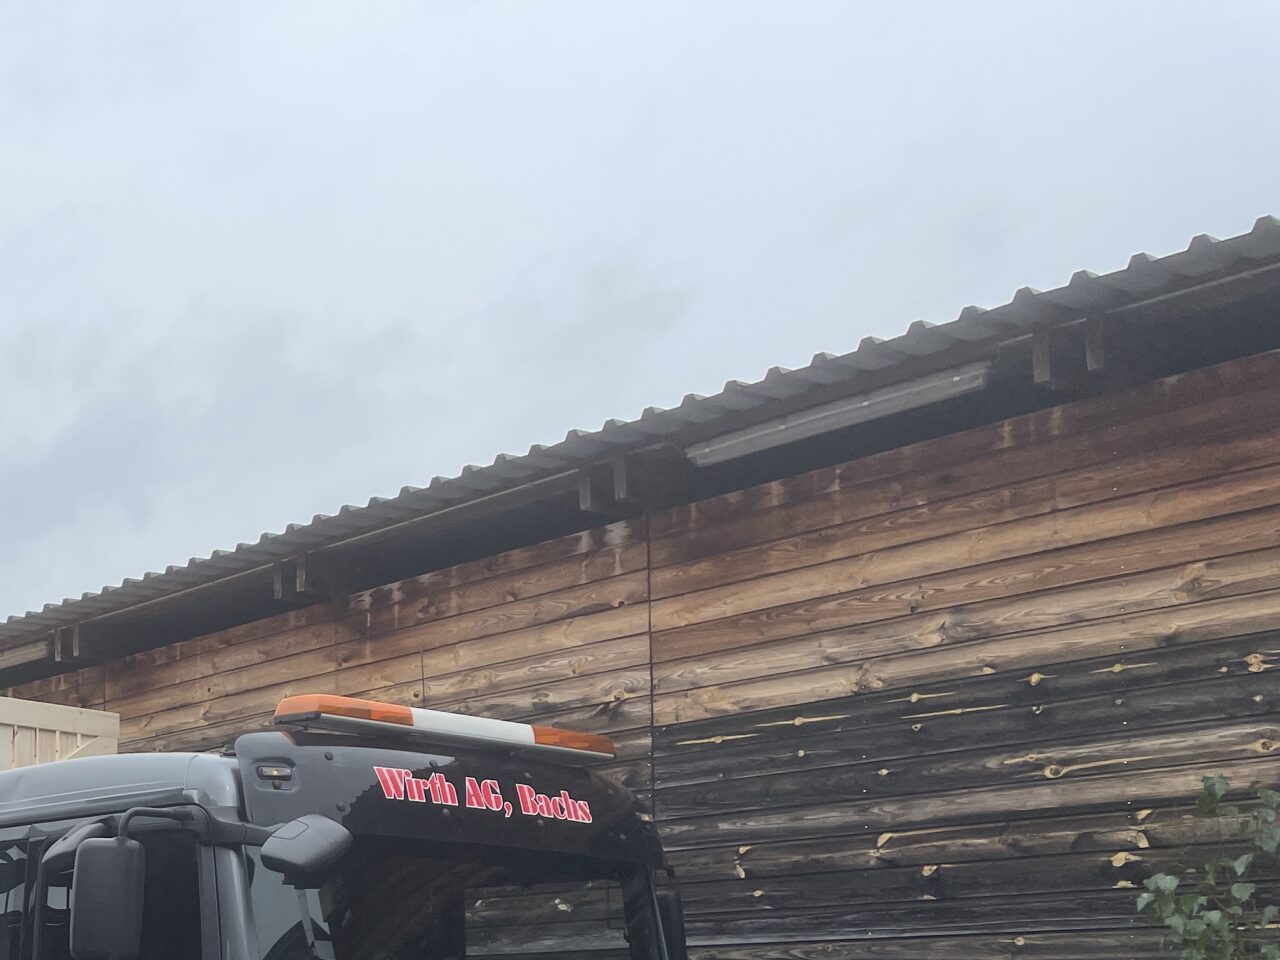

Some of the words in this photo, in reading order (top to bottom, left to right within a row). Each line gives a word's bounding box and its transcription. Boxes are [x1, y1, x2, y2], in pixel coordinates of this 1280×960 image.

[373, 766, 459, 807] Wirth
[465, 776, 513, 818] AG,
[516, 783, 593, 824] Bachs
